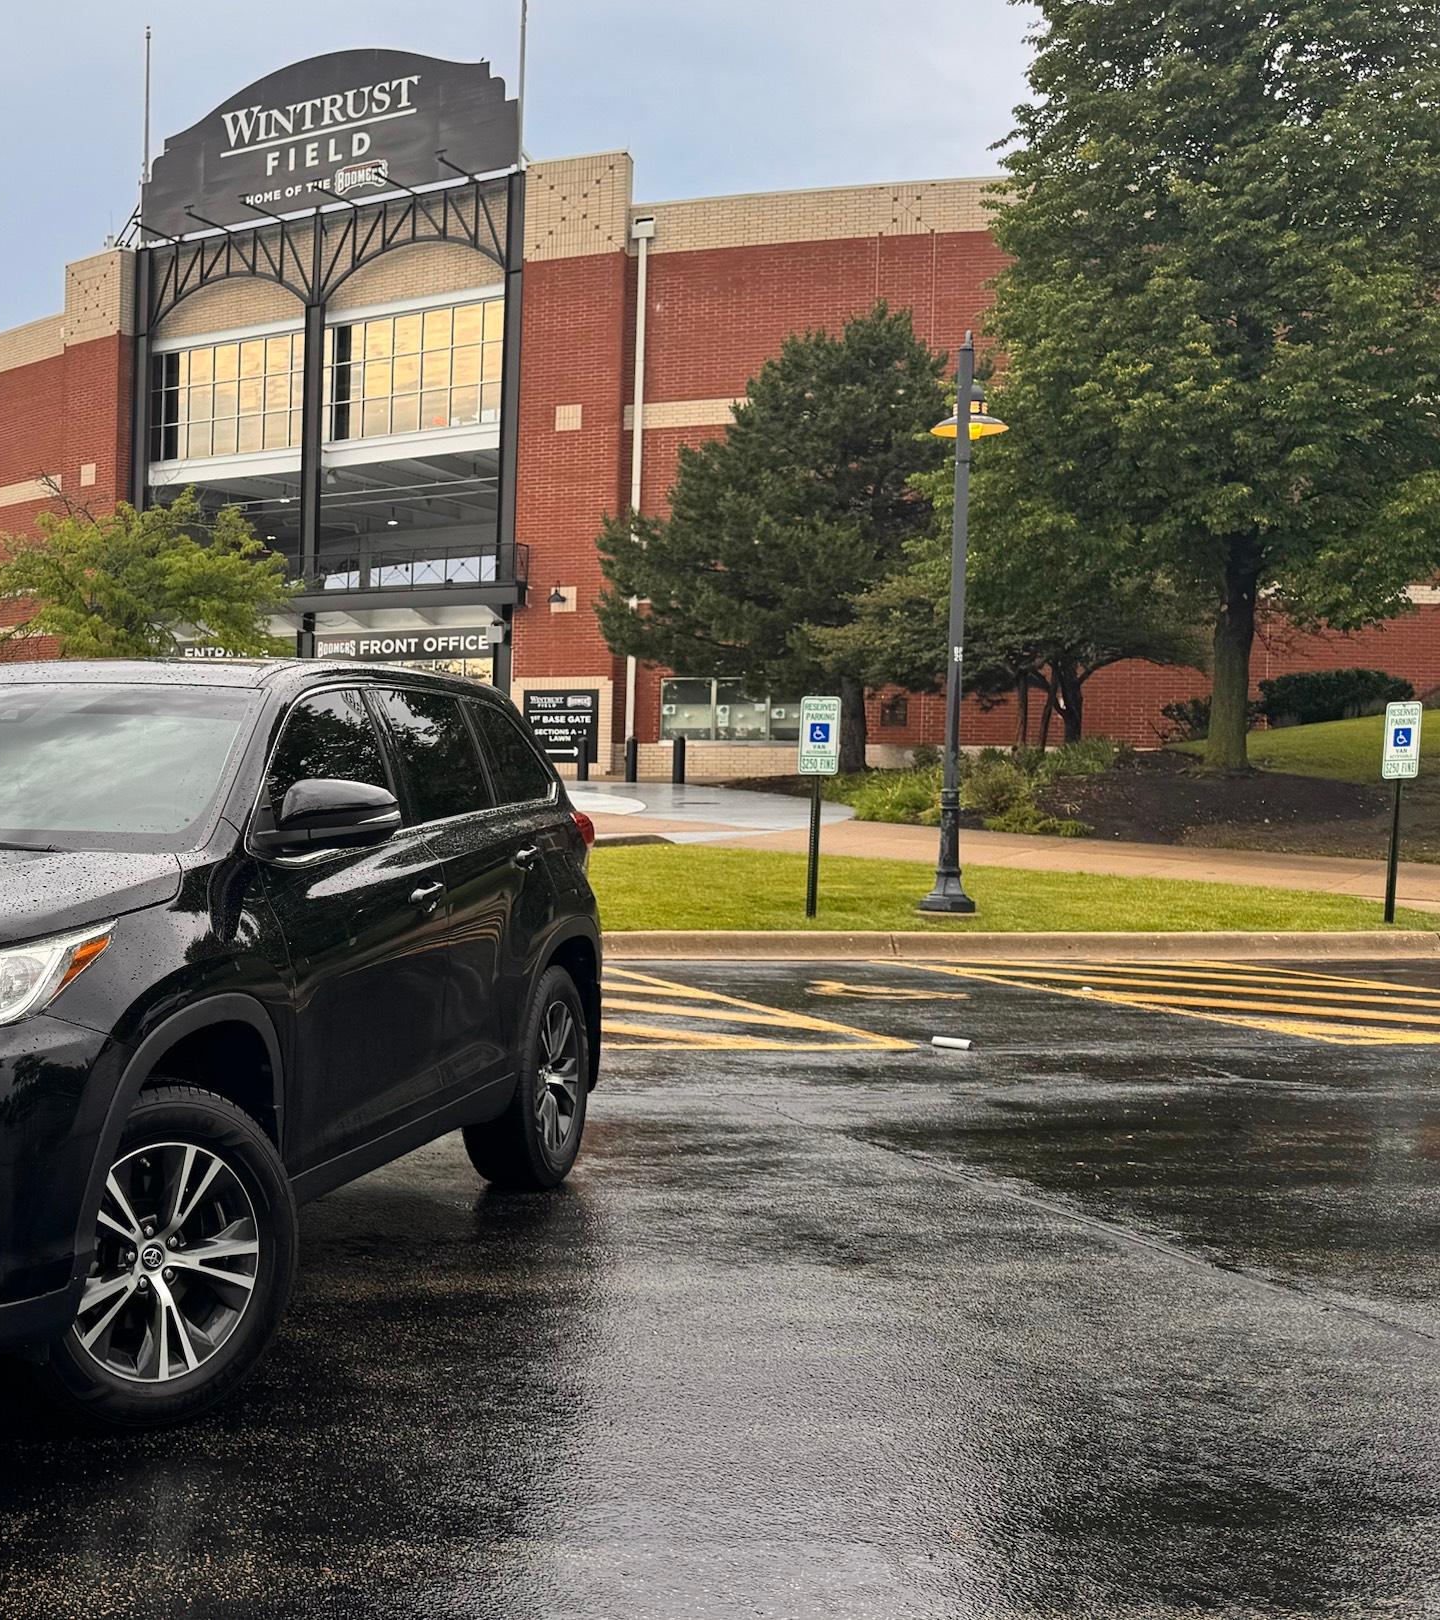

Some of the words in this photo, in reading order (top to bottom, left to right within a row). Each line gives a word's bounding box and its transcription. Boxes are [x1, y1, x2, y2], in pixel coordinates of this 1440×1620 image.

[220, 75, 421, 147] WINTRUST
[266, 132, 371, 176] FIELD
[245, 190, 281, 205] HOME
[285, 185, 302, 197] OF
[317, 639, 356, 658] BOOMERS
[360, 638, 419, 655] FRONT
[423, 635, 490, 654] OFFICE
[184, 647, 269, 657] ENTRA
[805, 703, 837, 711] RESERVED
[806, 712, 835, 720] PARKING
[1389, 708, 1418, 717] RESERVED
[542, 715, 566, 723] BASE
[567, 715, 592, 723] GATE
[1391, 718, 1417, 726] PARKING
[534, 728, 570, 736] SECTIONS
[802, 758, 818, 770] $250
[820, 759, 834, 769] FINE
[1385, 762, 1400, 774] $250
[1401, 762, 1415, 773] FINE
